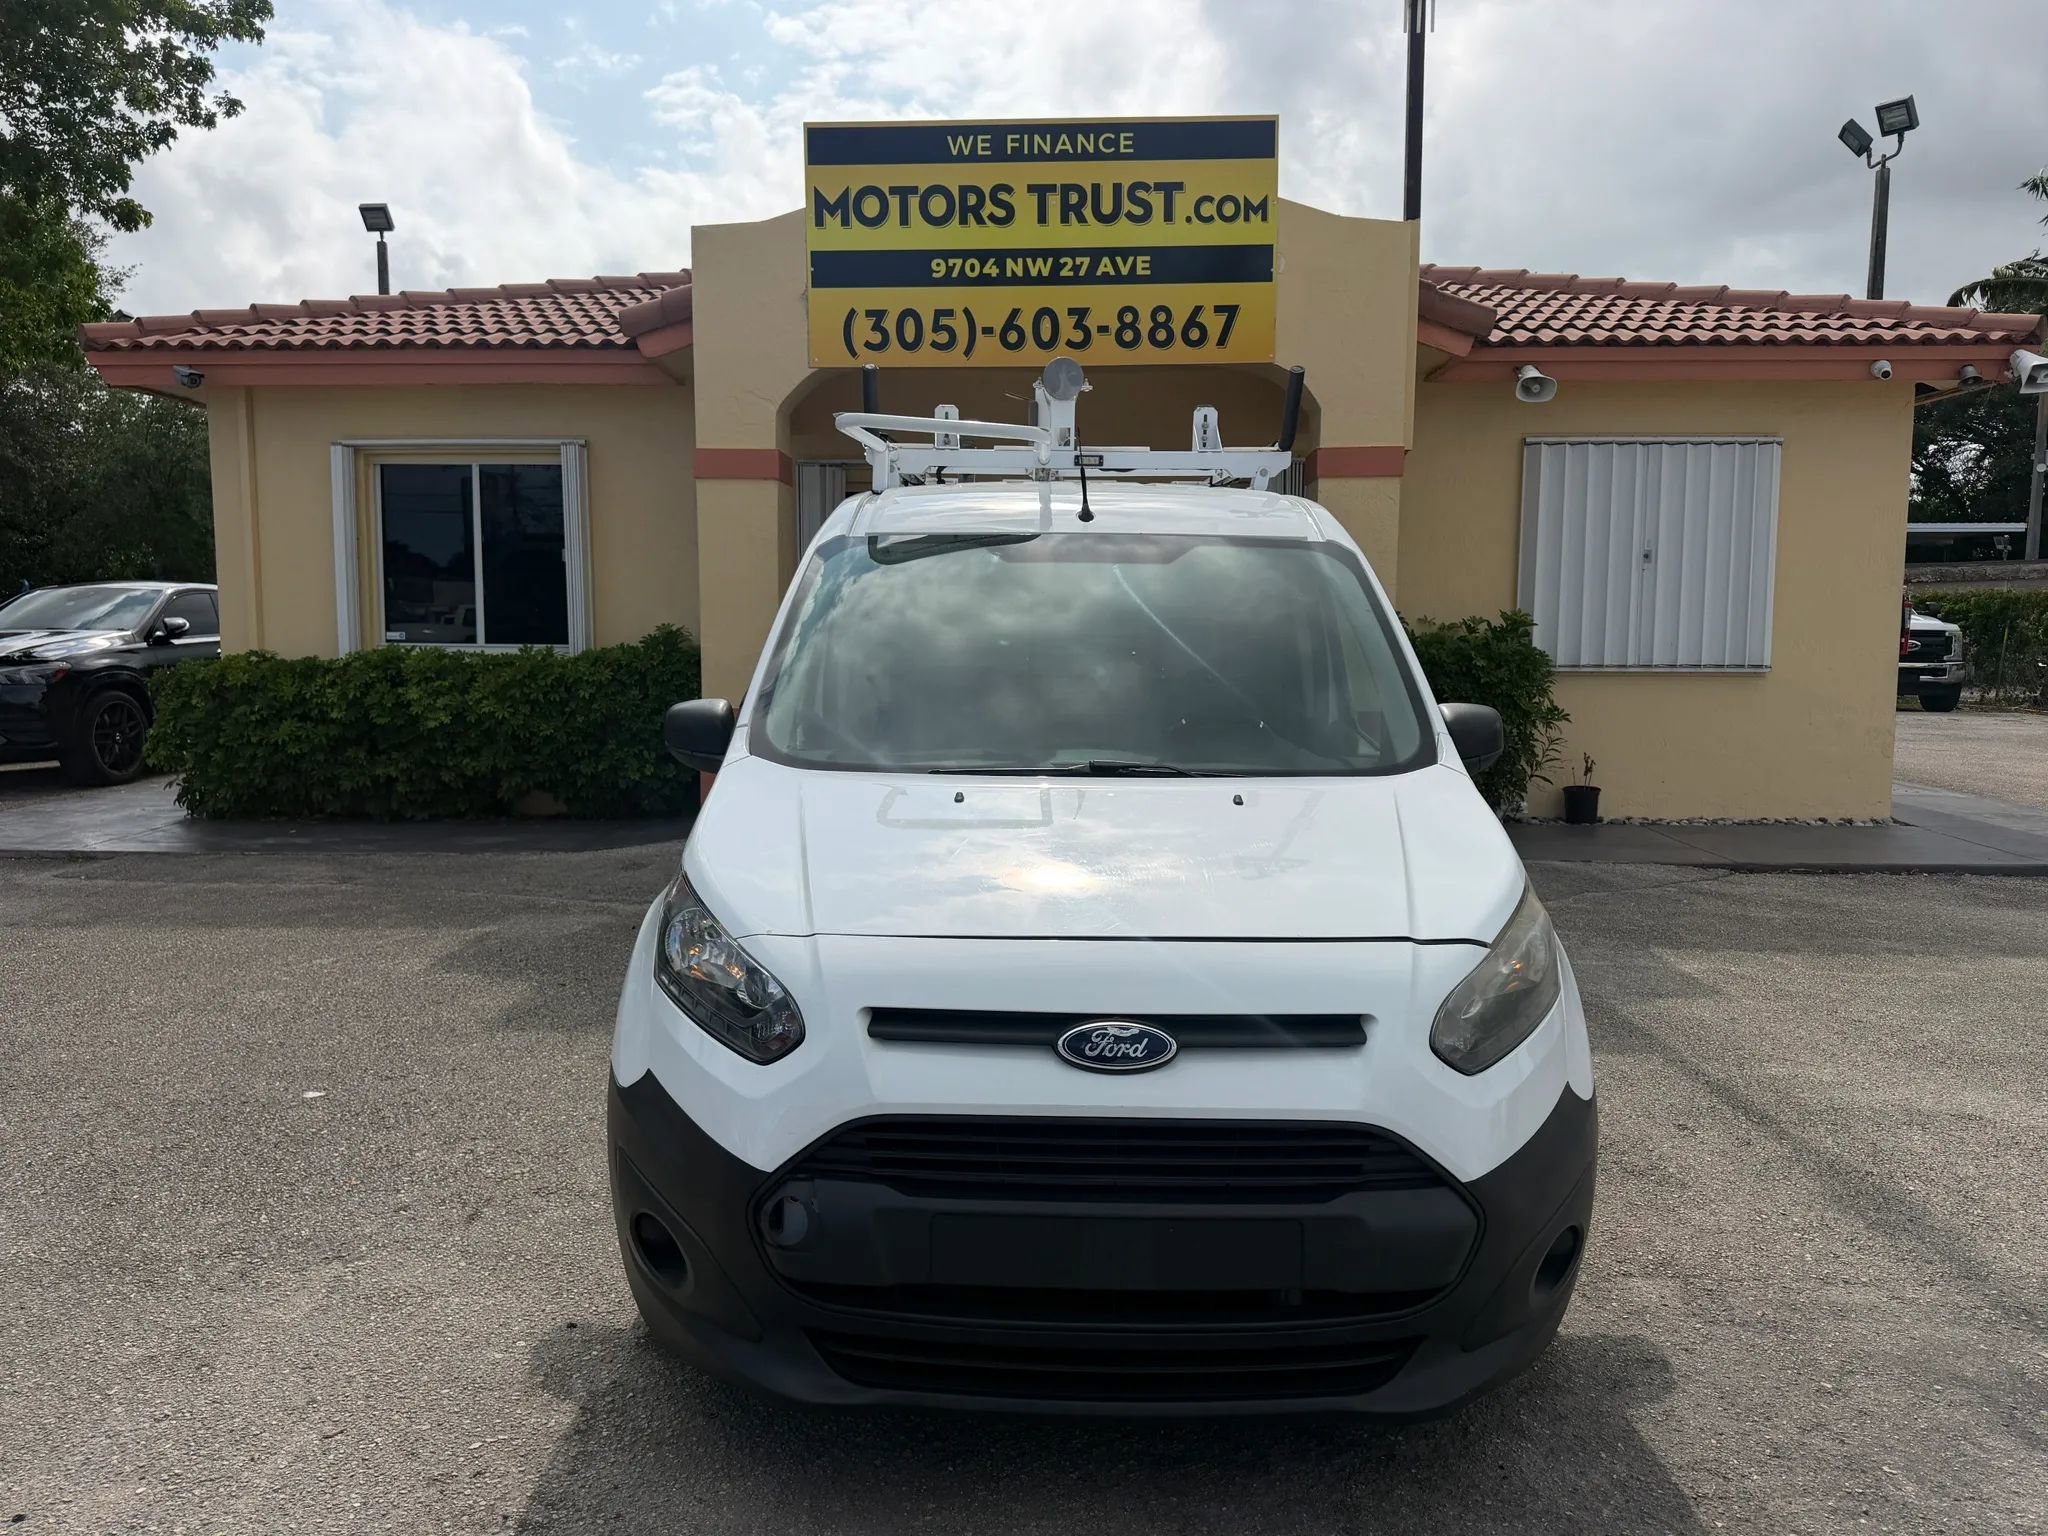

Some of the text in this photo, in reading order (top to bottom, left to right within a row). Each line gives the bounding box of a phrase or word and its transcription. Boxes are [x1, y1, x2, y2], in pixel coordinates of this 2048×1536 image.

[947, 132, 1135, 156] WE FINANCE
[813, 183, 1016, 229] MOTORS
[930, 256, 1152, 279] 9704 NW 27 AVE
[842, 305, 1241, 360] (305)-603-8867
[1085, 1027, 1148, 1057] Ford
